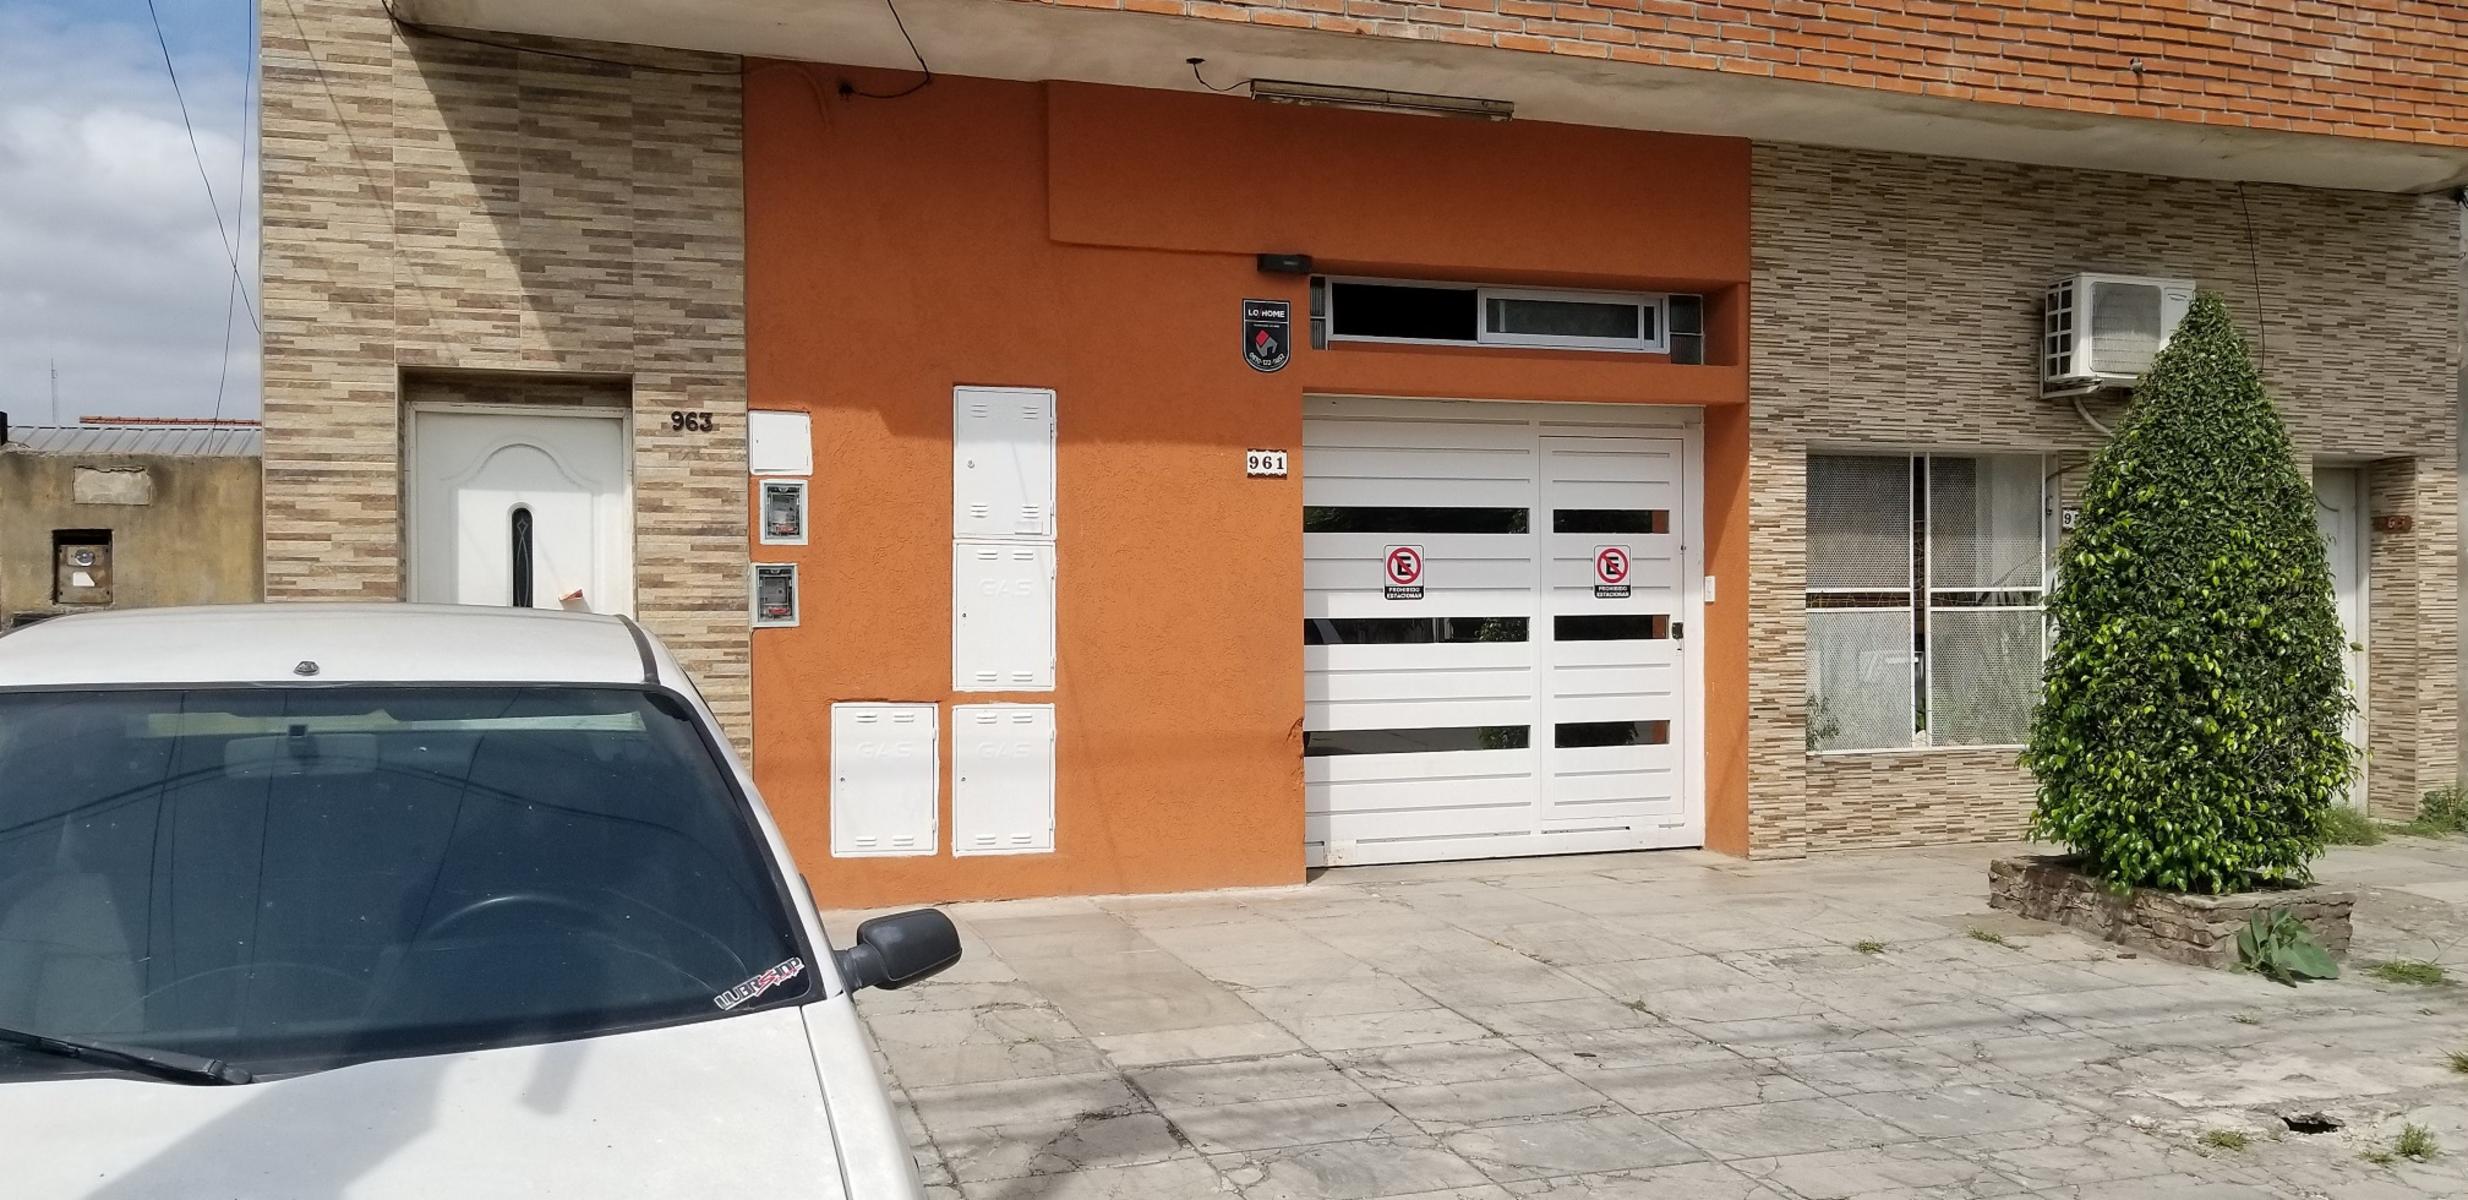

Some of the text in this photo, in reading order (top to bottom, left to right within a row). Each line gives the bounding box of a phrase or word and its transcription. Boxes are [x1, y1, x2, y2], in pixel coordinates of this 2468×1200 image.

[1261, 310, 1286, 318] HOME
[670, 410, 714, 432] 963
[1248, 455, 1285, 470] 961
[1396, 556, 1412, 576] E
[1605, 556, 1619, 575] E
[977, 577, 1033, 597] GAS
[856, 741, 912, 759] GAS
[976, 741, 1033, 759] GAS
